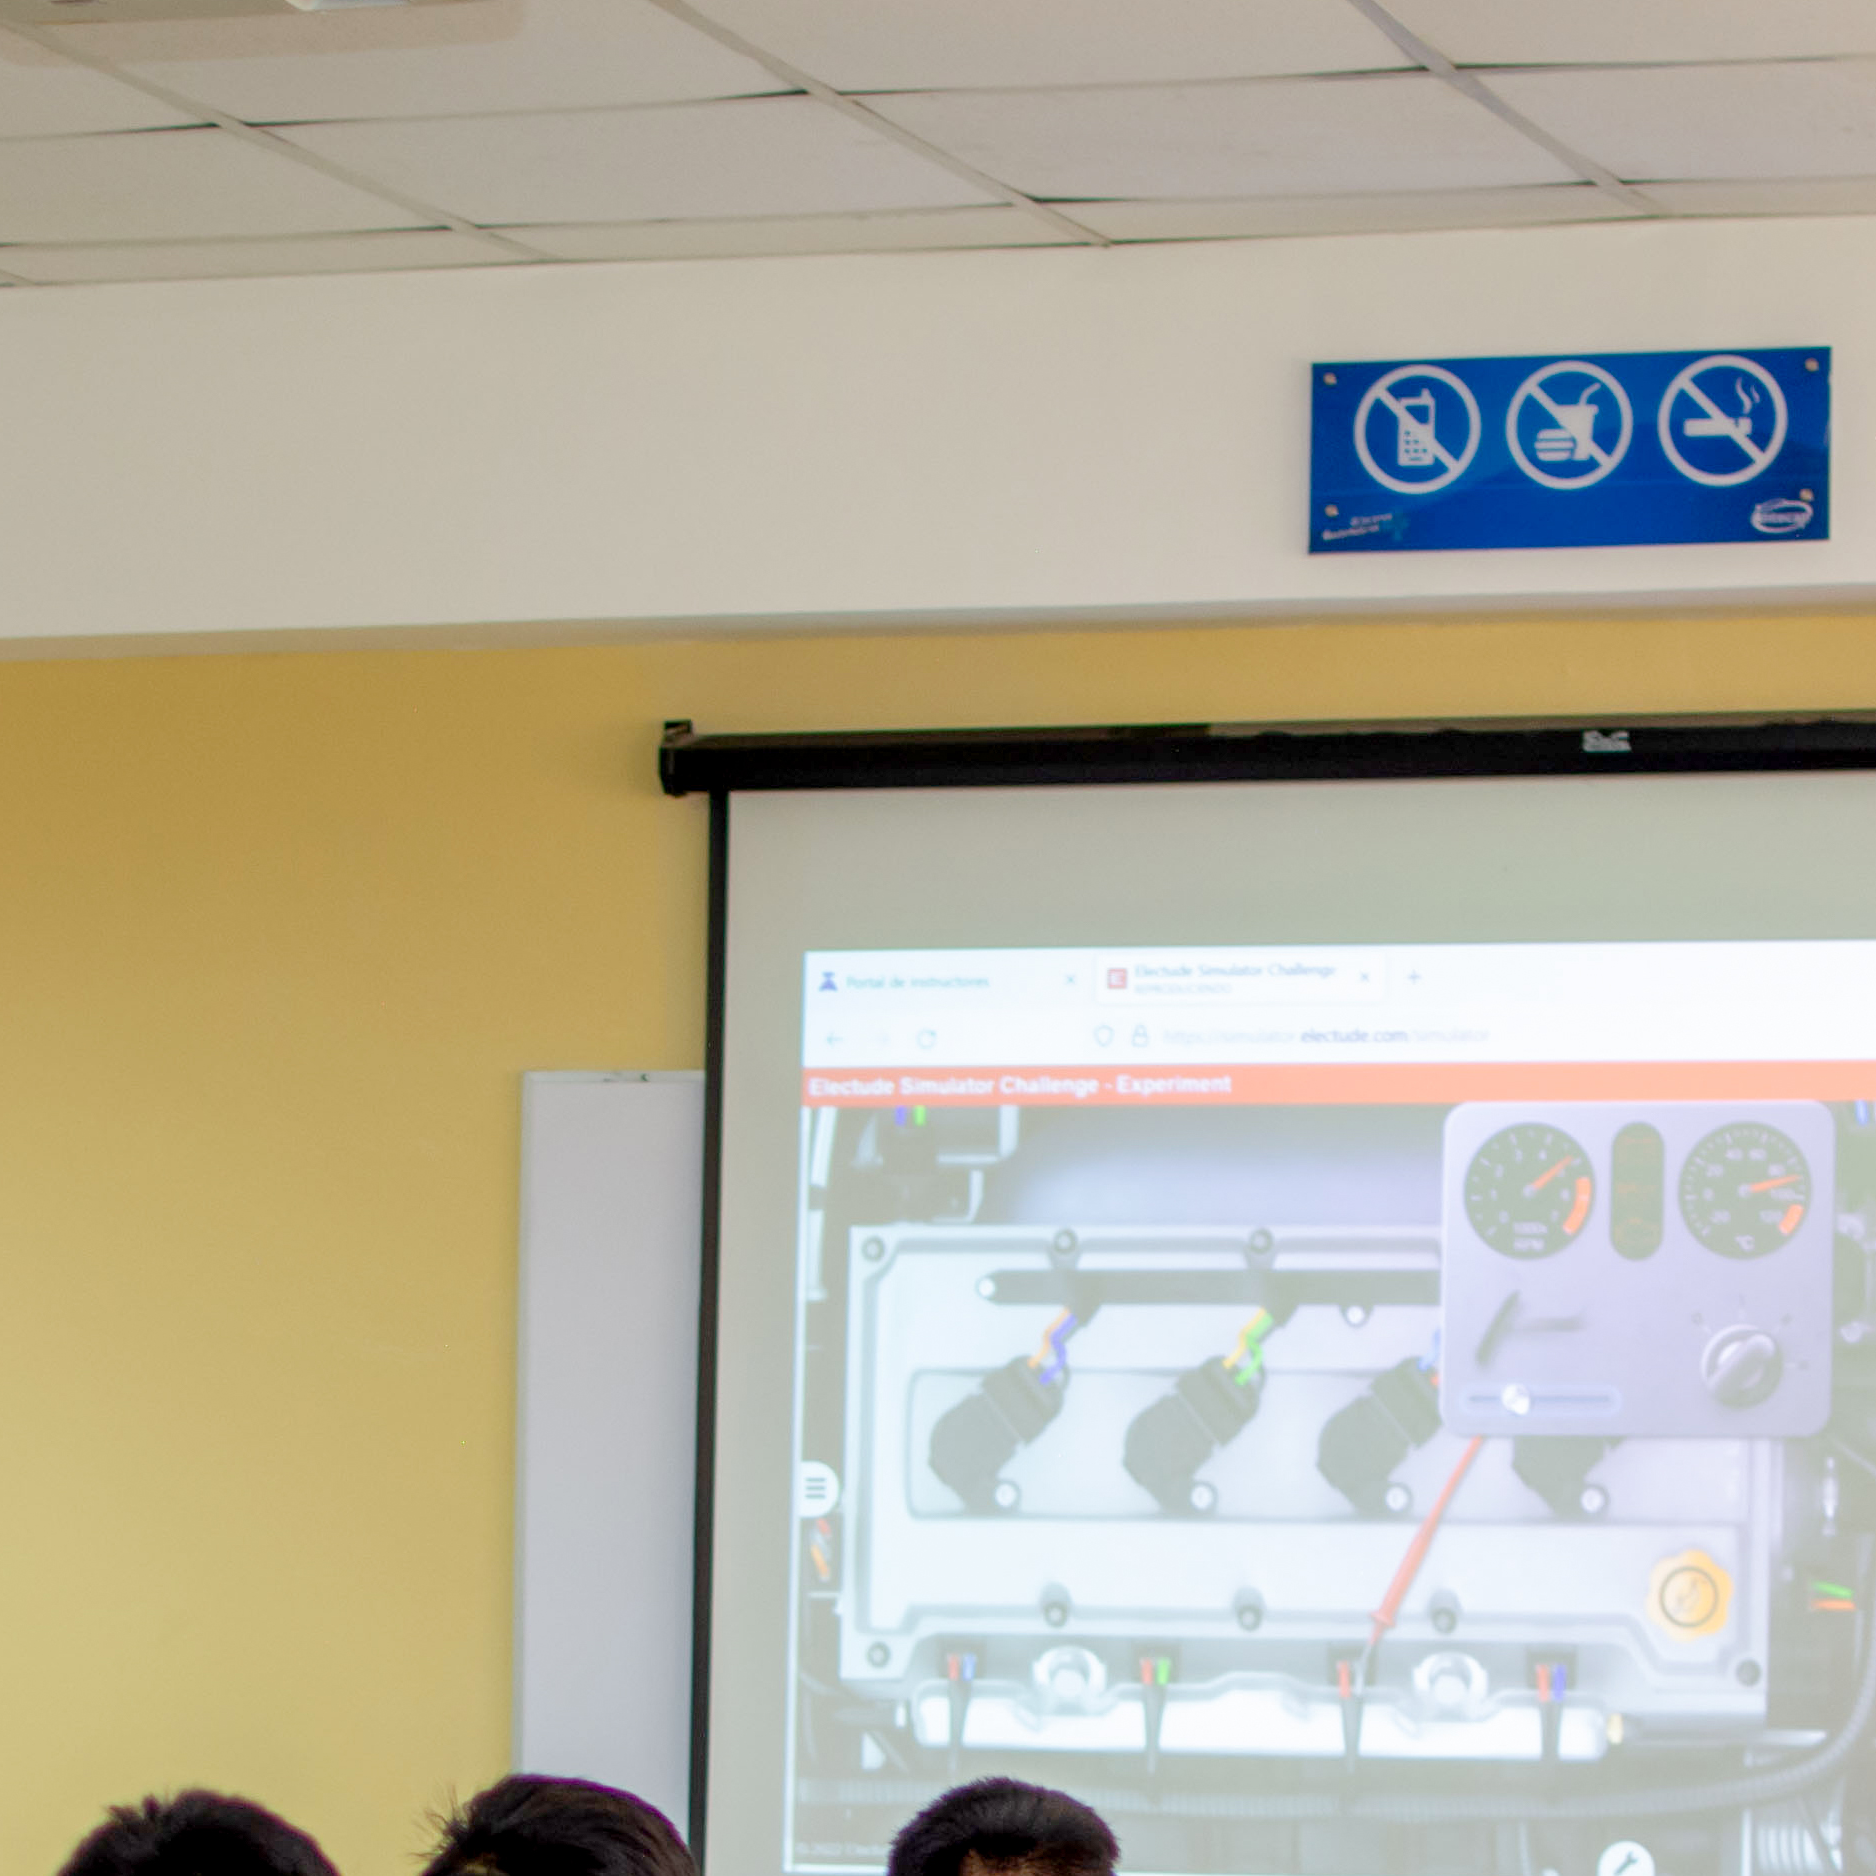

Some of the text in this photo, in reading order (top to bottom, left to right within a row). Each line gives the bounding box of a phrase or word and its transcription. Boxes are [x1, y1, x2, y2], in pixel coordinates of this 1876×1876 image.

[1134, 963, 1193, 977] Electude
[1198, 962, 1262, 977] Simulator
[846, 974, 990, 988] Portal de instructores
[808, 1077, 895, 1096] Electude
[899, 1076, 994, 1096] Simulator
[998, 1075, 1099, 1099] Challenge
[1116, 1074, 1232, 1099] Experiment
